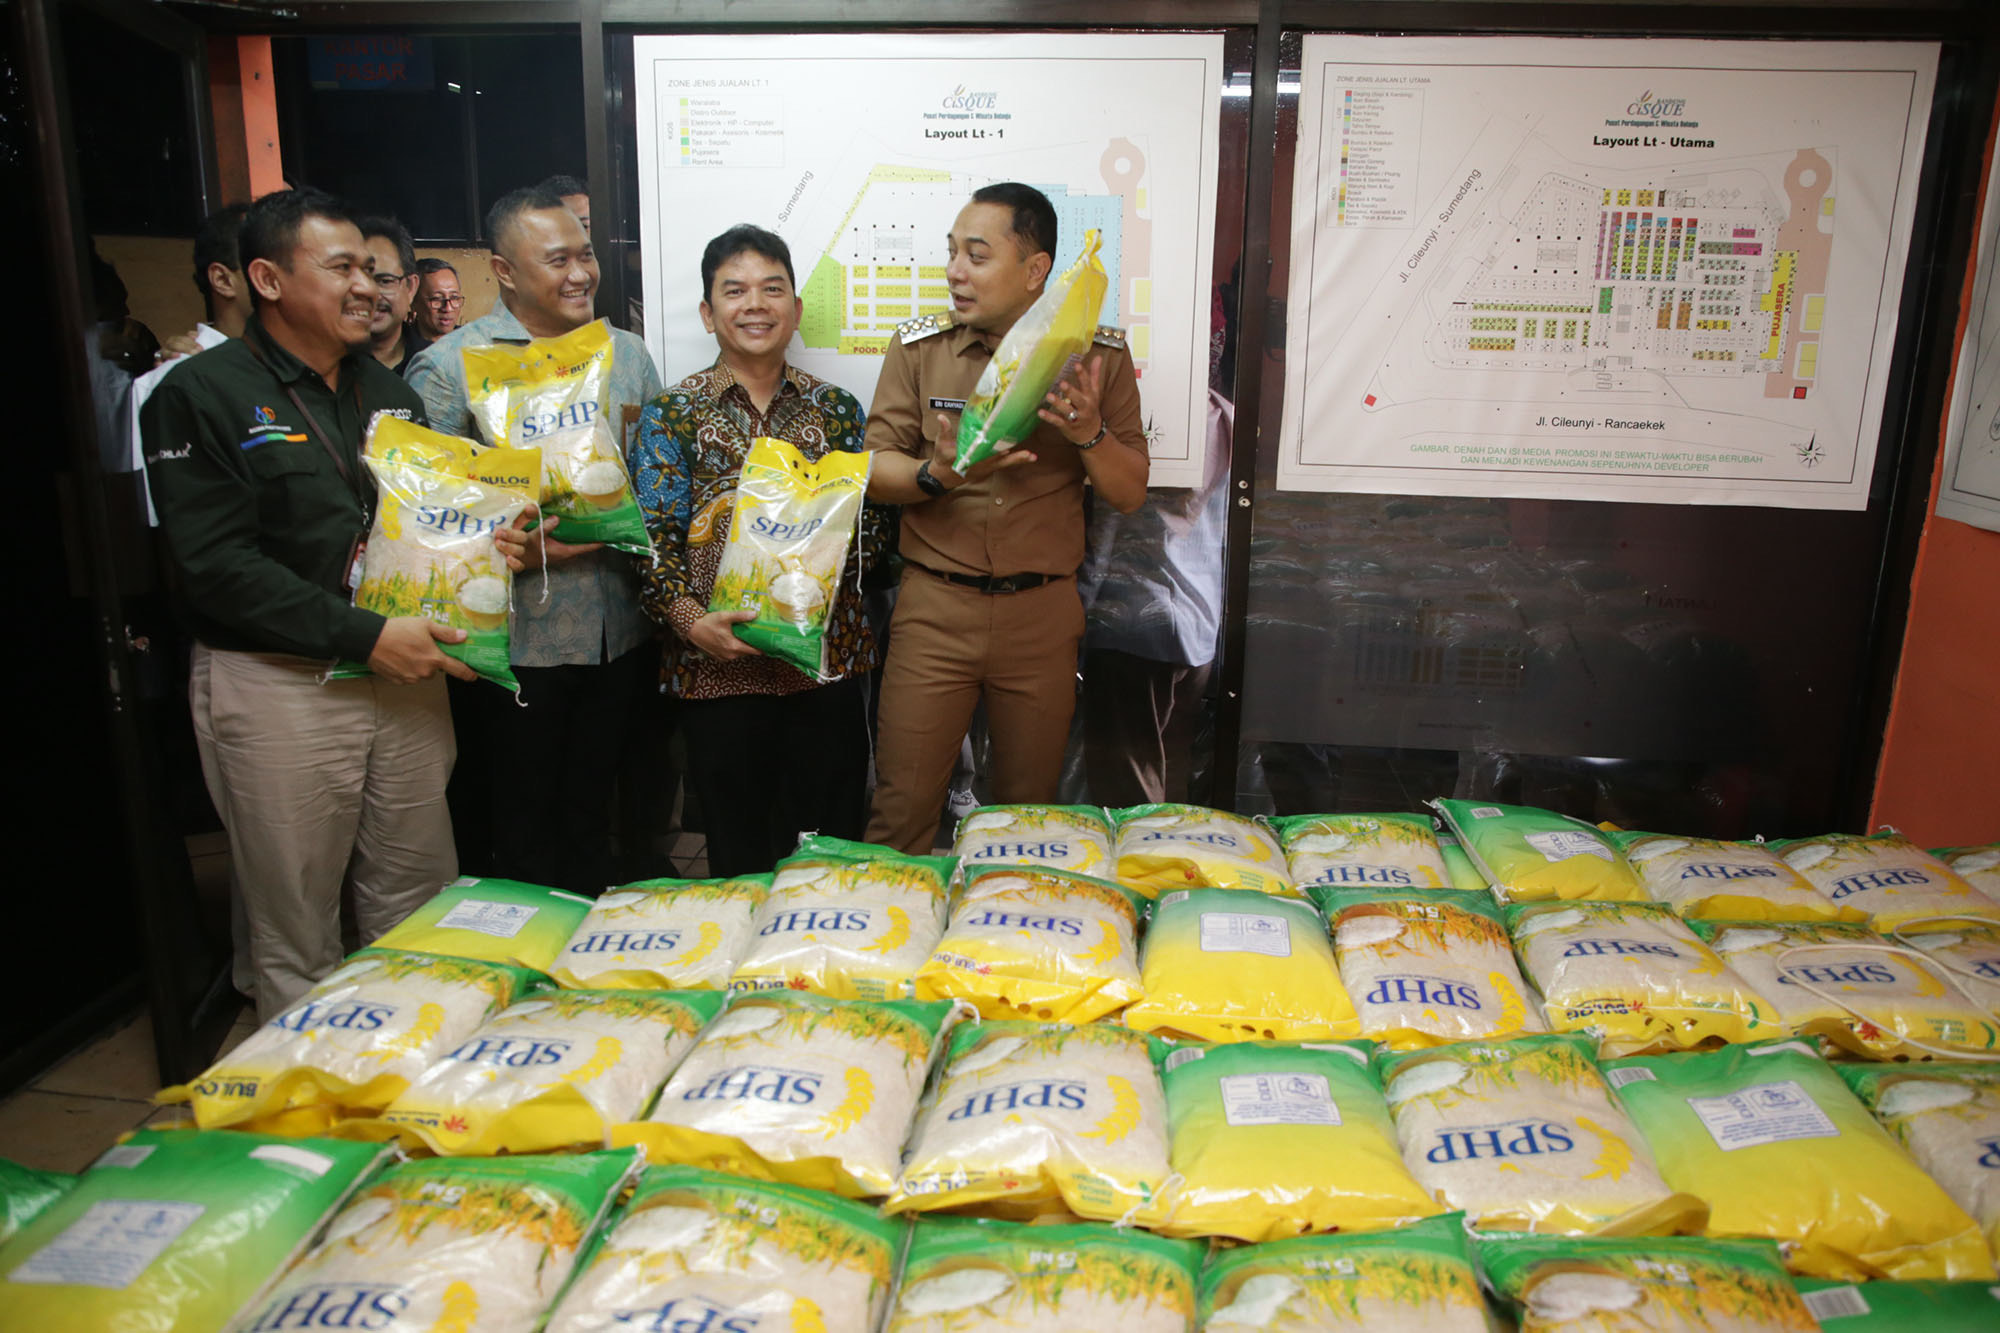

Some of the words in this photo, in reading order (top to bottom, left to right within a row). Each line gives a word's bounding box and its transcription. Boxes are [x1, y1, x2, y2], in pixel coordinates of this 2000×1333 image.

[335, 63, 408, 81] PASAR
[668, 80, 690, 88] ZONE
[693, 80, 716, 88] JENIS
[718, 80, 750, 88] JUALAN
[925, 128, 968, 140] Layout
[972, 128, 985, 138] Lt
[998, 128, 1004, 138] 1
[1593, 136, 1640, 149] Layout
[1643, 136, 1658, 147] Lt
[1670, 137, 1715, 148] Utama
[778, 170, 815, 223] Sumedang
[1400, 272, 1412, 284] Jl.
[1408, 228, 1438, 270] Cileunyi
[1438, 168, 1482, 222] Sumedang
[1770, 282, 1786, 337] PUJASERA
[853, 346, 878, 354] FOOD
[569, 350, 606, 375] BUG
[521, 400, 600, 439] SPHP
[1536, 416, 1548, 427] Jl.
[1552, 416, 1594, 430] Cileunyi
[1604, 418, 1666, 430] Rancaekek
[1454, 445, 1486, 454] DENAH
[1488, 446, 1506, 456] DAN
[1508, 447, 1520, 456] ISI
[1522, 448, 1551, 456] MEDIA
[1555, 449, 1598, 458] PROMOSI
[1614, 451, 1694, 462] SEWAKTU-WAKTU
[1696, 454, 1717, 462] BISA
[1718, 454, 1764, 464] BERUBAH
[1460, 456, 1480, 464] DAN
[1482, 456, 1522, 466] MENJADI
[1524, 458, 1588, 468] KEWENANGAN
[1591, 460, 1652, 470] SEPENUHNYA
[1654, 462, 1710, 472] DEVELOPER
[480, 475, 530, 486] BULOG
[416, 504, 508, 536] SPHP
[750, 515, 824, 541] SPHP
[740, 594, 750, 608] 5
[420, 603, 434, 618] 5
[434, 608, 450, 624] kg
[974, 843, 1069, 860] SPHP
[1315, 867, 1412, 884] SPHP
[1681, 864, 1778, 880] SPHP
[1832, 870, 1930, 900] SPHP
[1406, 903, 1425, 914] kg
[1426, 906, 1440, 918] 5
[760, 912, 871, 936] SPHP
[968, 912, 1083, 936] SPHP
[570, 932, 681, 954] SPHP
[1564, 940, 1680, 958] SPHP
[1776, 965, 1896, 986] SPHP
[1366, 978, 1482, 1011] SPHP
[1566, 1003, 1629, 1021] BULOG
[1494, 1048, 1510, 1062] 5
[682, 1072, 822, 1106] SPHP
[948, 1084, 1088, 1122] SPHP
[1426, 1121, 1576, 1164] SPHP
[1666, 1264, 1690, 1282] 5
